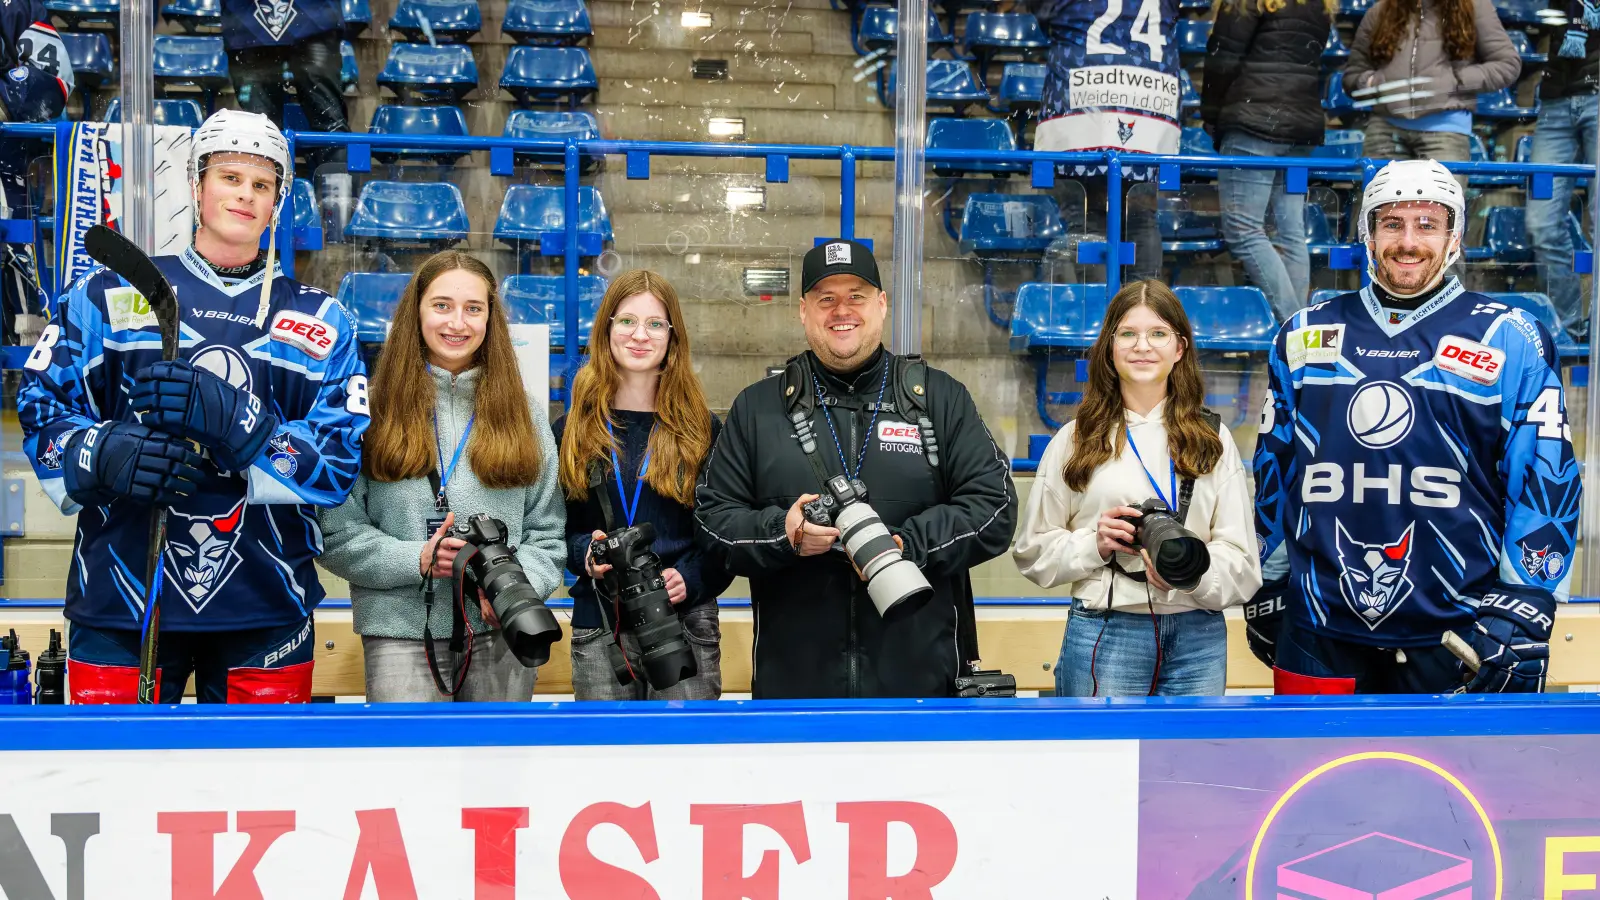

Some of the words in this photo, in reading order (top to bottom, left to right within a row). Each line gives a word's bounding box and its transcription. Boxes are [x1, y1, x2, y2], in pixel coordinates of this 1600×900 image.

[1086, 0, 1167, 62] 24
[1073, 69, 1177, 95] Stadtwerke
[1073, 90, 1128, 107] Weiden
[1301, 462, 1462, 508] BHS
[157, 799, 958, 900] KAISER
